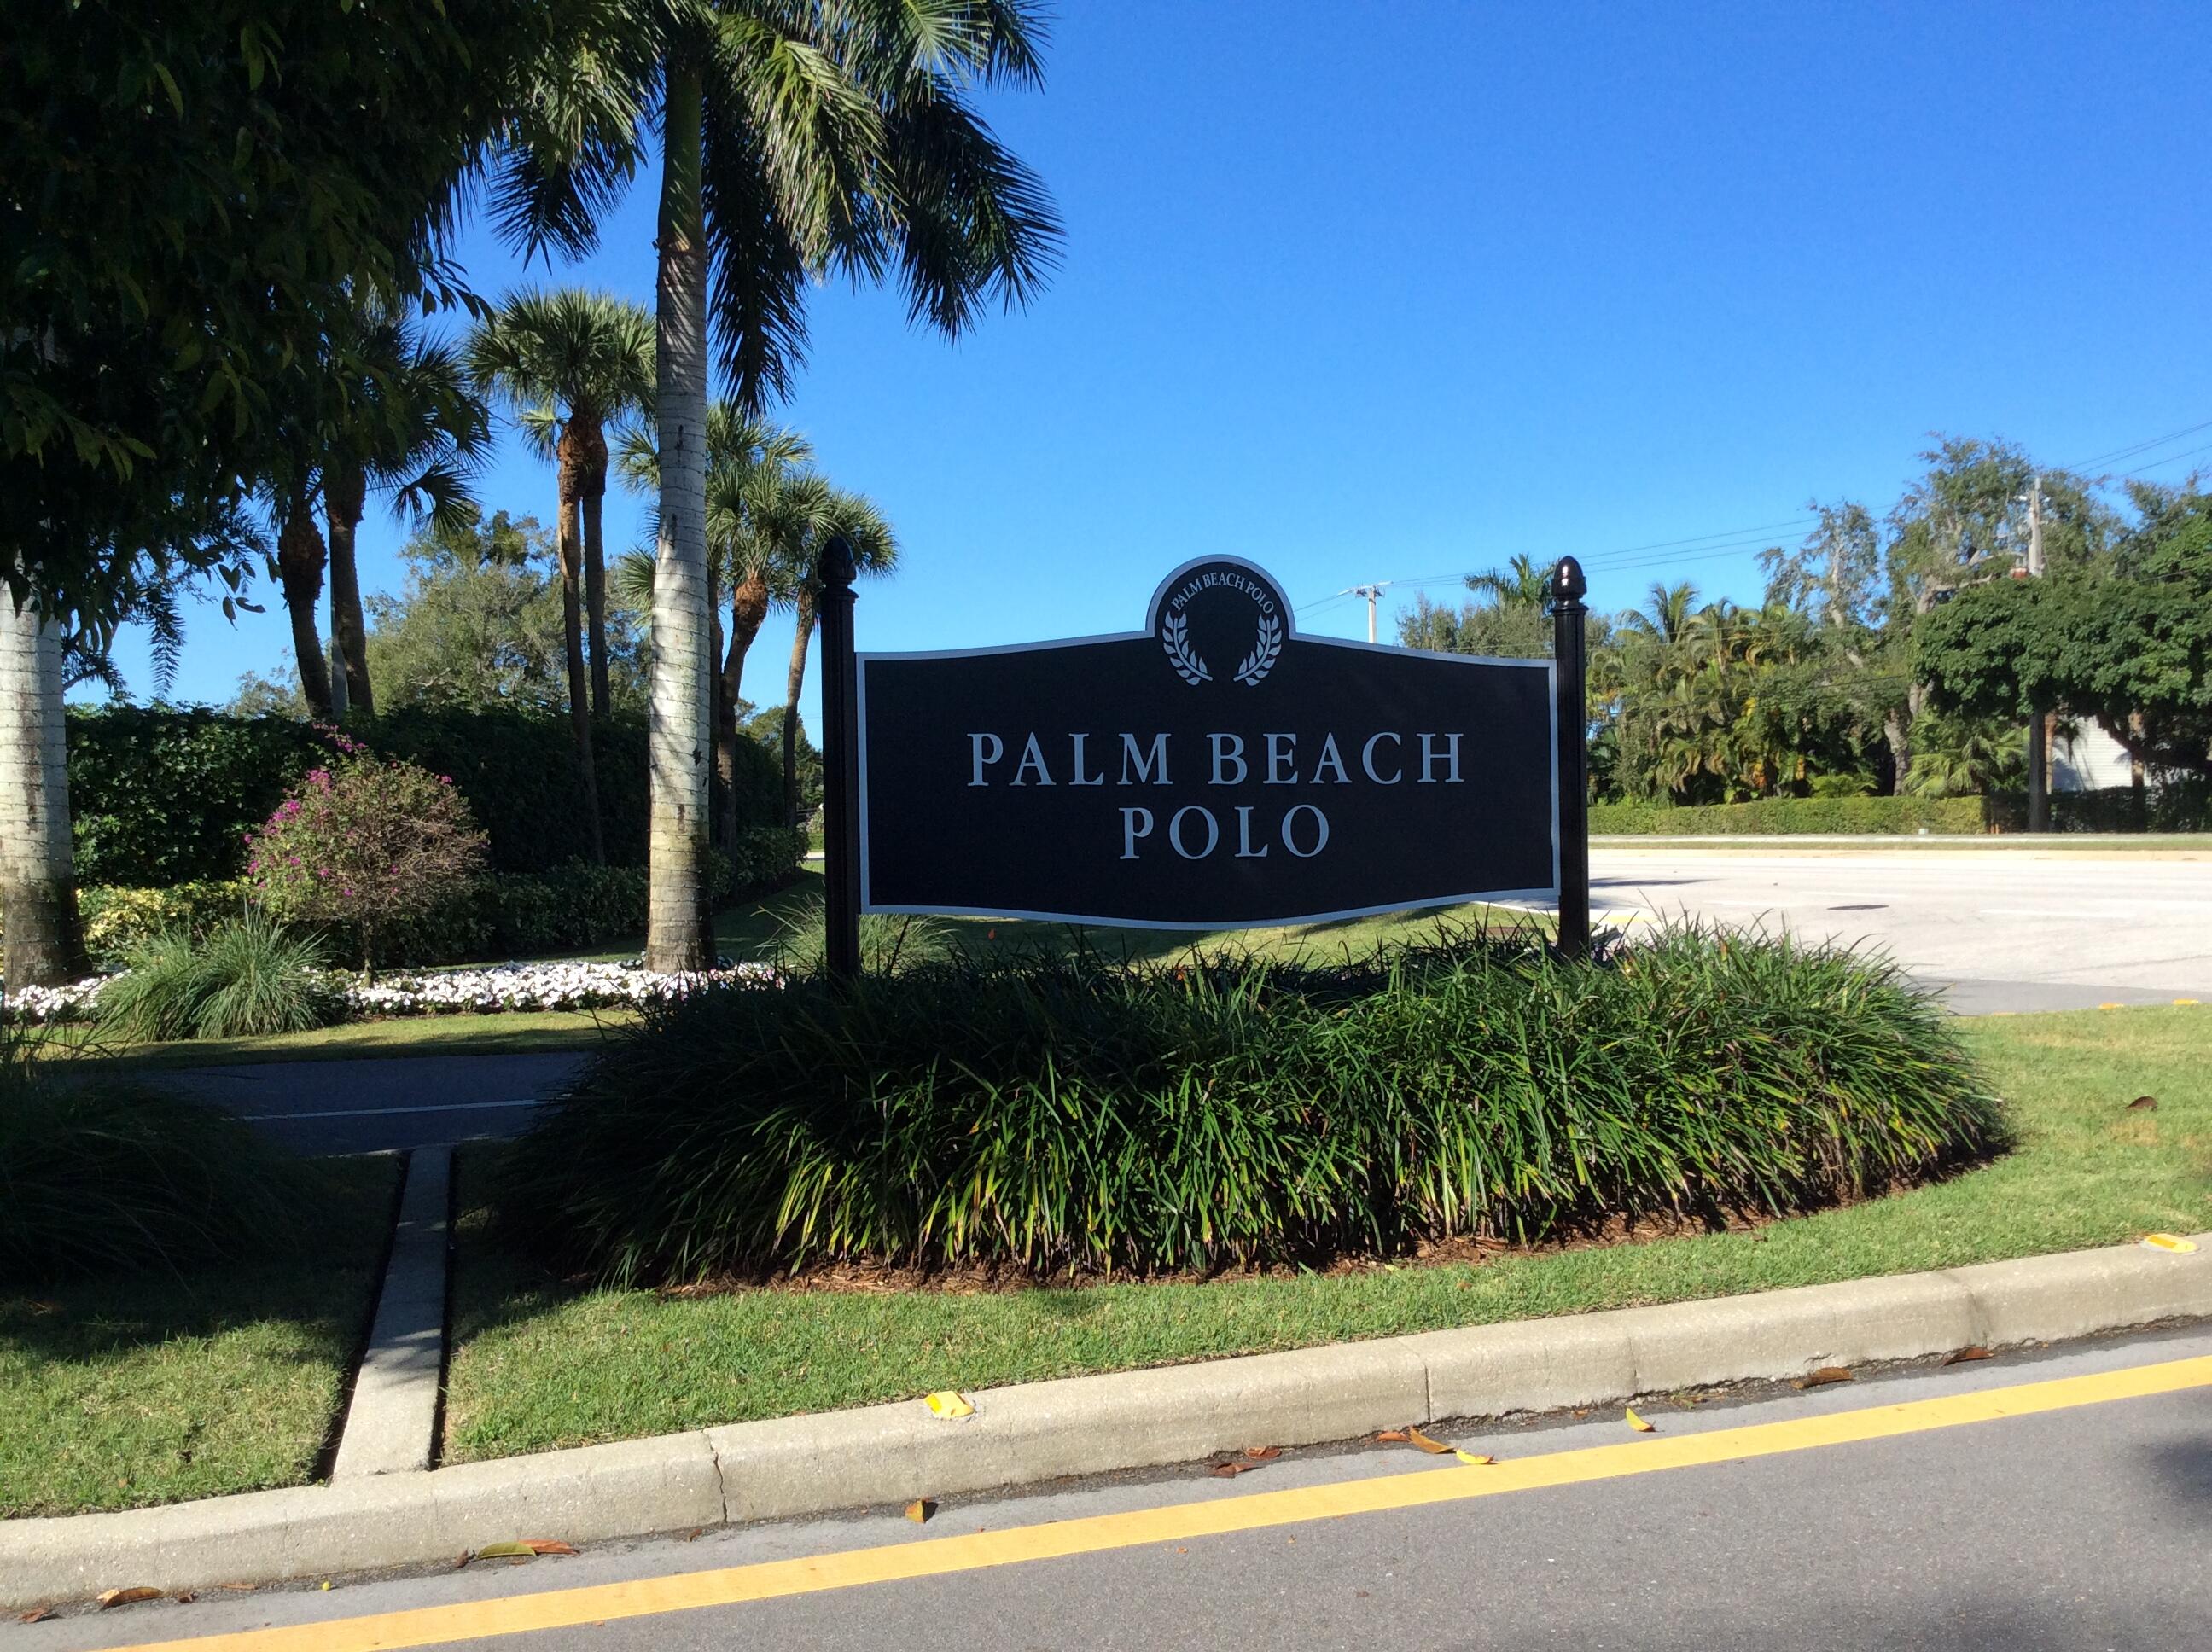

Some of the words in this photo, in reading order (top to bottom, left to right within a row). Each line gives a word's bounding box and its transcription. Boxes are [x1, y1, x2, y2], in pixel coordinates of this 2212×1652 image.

[1172, 578, 1203, 611] PALM
[1202, 572, 1246, 590] BEACH
[1244, 581, 1274, 614] POLO
[967, 731, 1173, 786] PALM
[1206, 731, 1464, 784] BEACH
[1118, 804, 1330, 859] POLO
